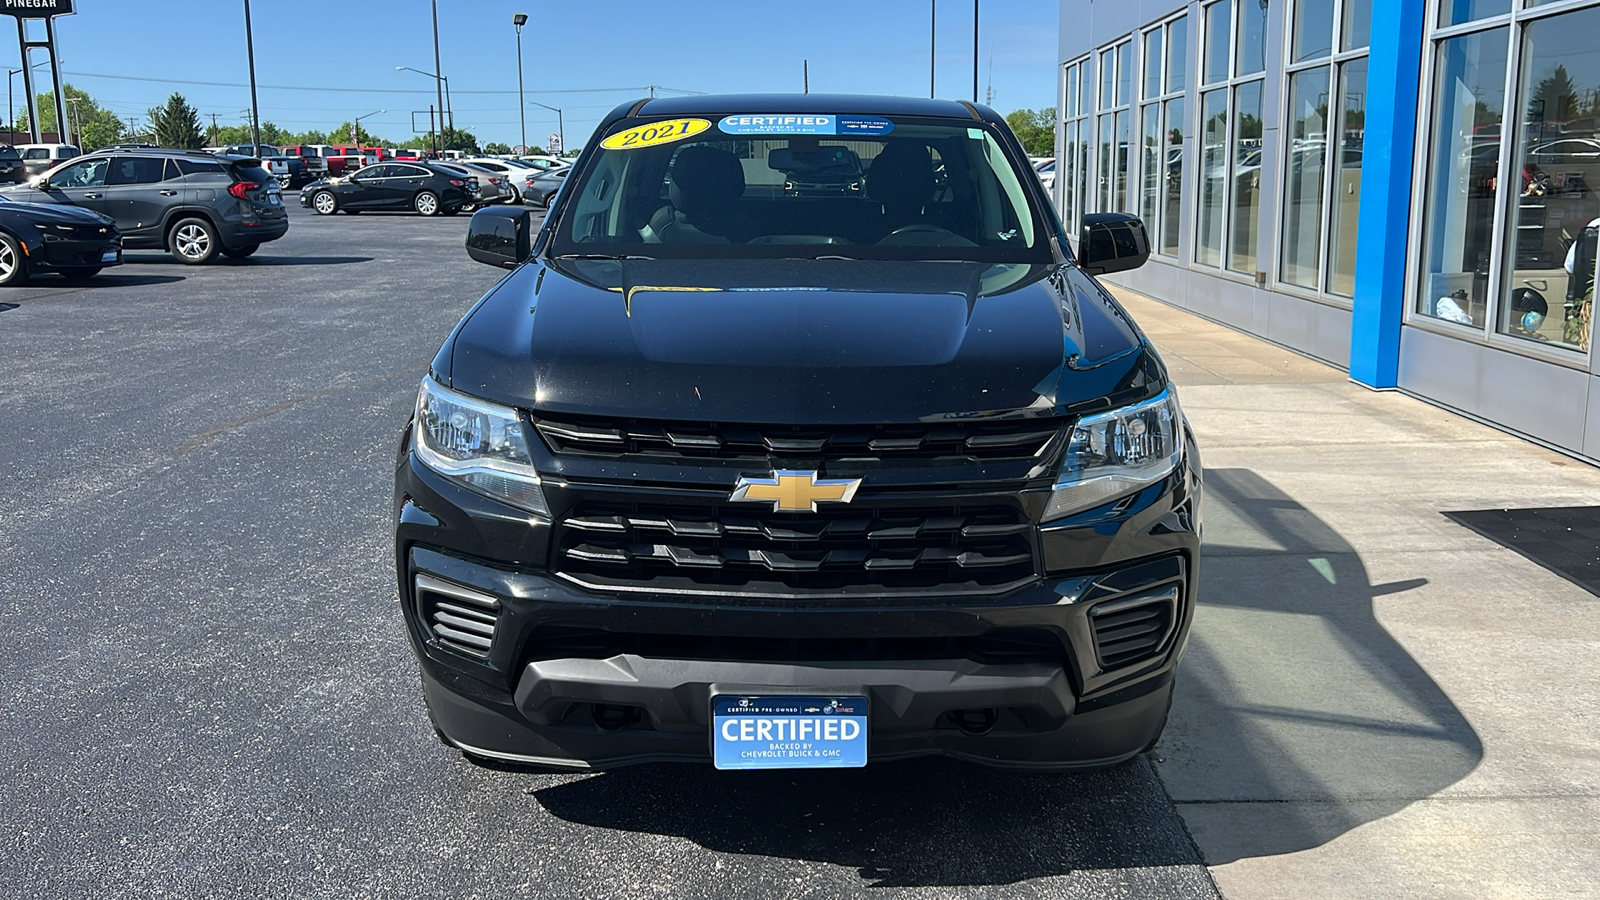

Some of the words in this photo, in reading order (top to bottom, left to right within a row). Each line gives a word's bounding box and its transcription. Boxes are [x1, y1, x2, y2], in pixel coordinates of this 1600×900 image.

[6, 0, 56, 8] PINEGAR
[725, 117, 829, 126] CERTIFIED
[621, 121, 690, 147] 2021
[721, 719, 860, 742] CERTIFIED
[741, 750, 786, 758] CHEVROLET
